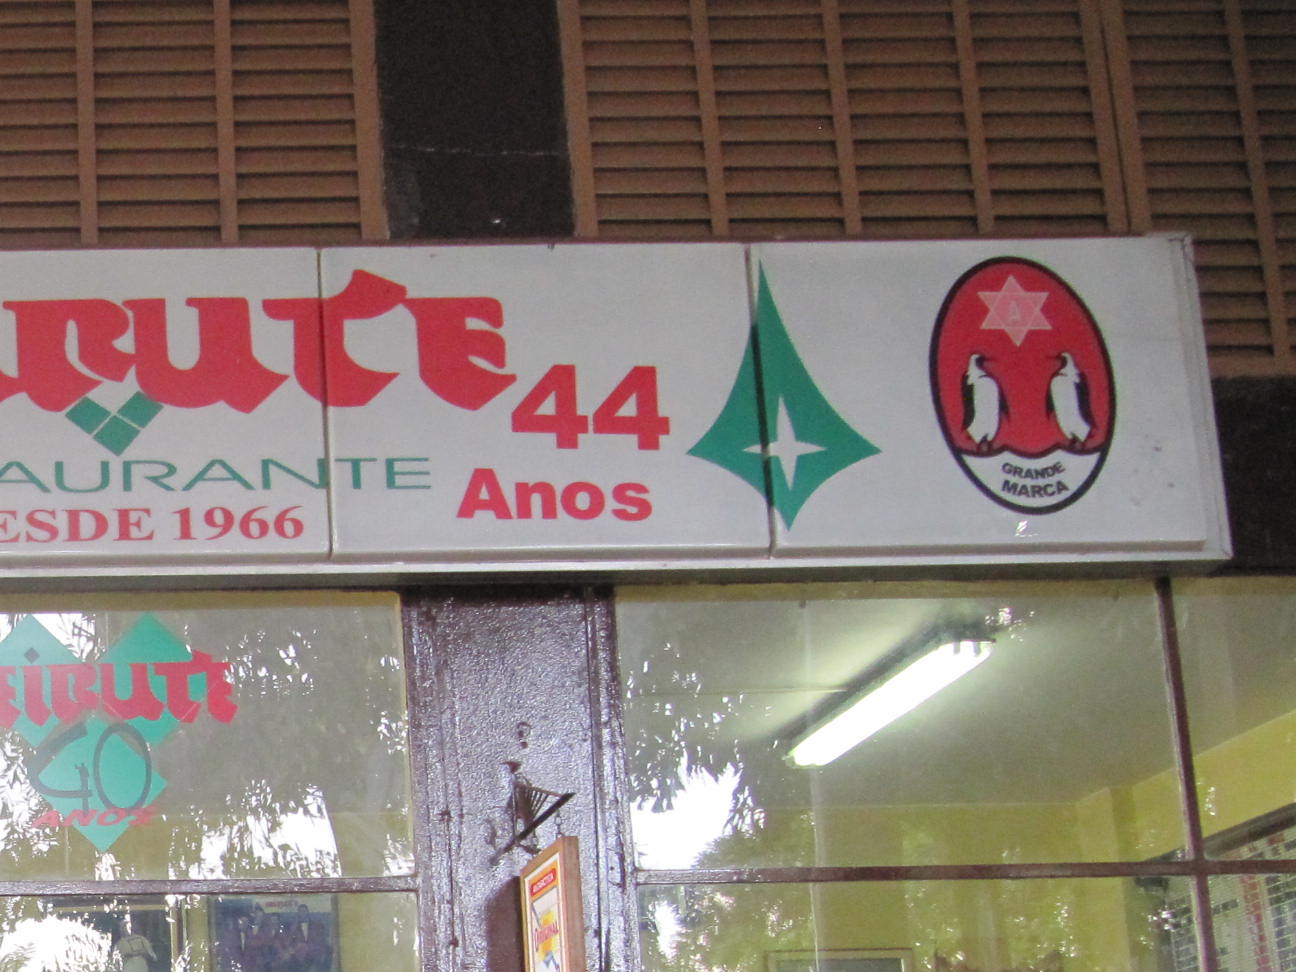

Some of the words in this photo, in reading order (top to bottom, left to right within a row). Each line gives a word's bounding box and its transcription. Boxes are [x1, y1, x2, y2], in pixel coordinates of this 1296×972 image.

[510, 363, 671, 451] 44
[1000, 479, 1070, 498] MARCA
[1001, 461, 1066, 480] GRANDE
[456, 467, 653, 522] Anos
[172, 505, 305, 541] 1966
[26, 721, 153, 818] 40
